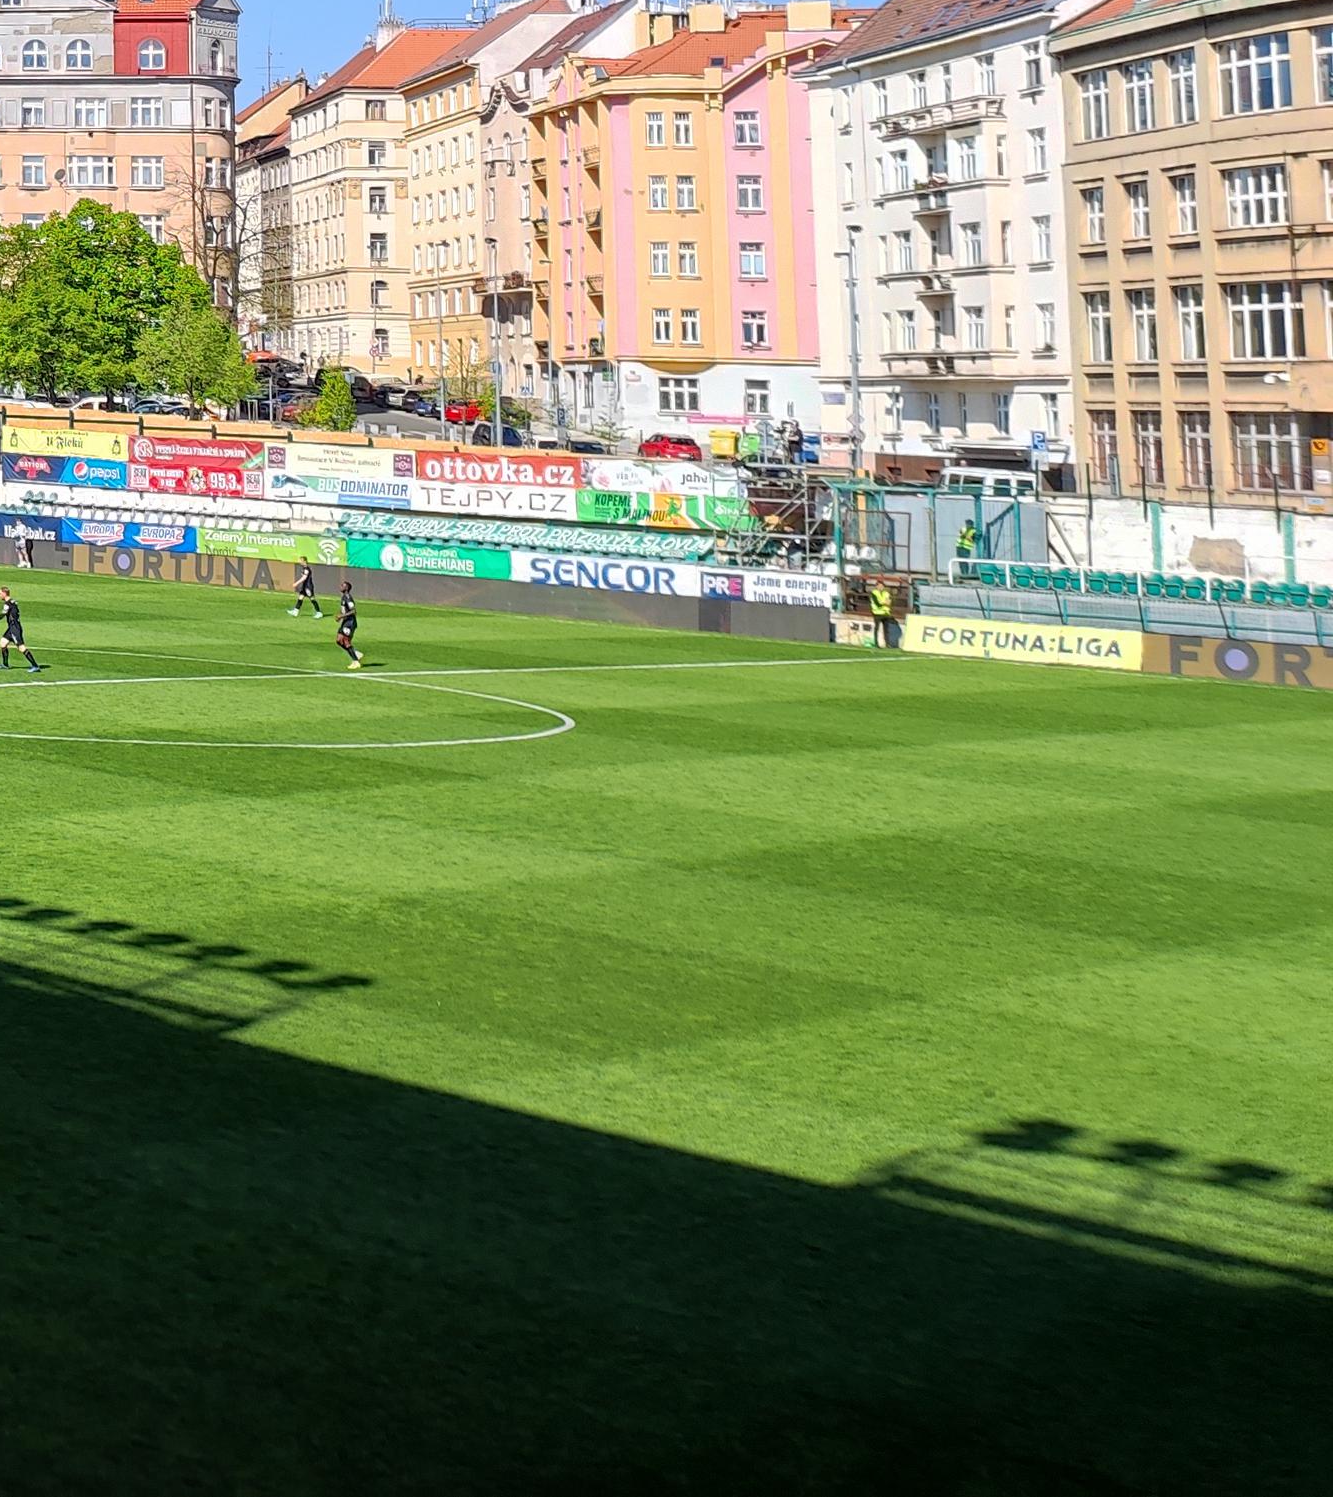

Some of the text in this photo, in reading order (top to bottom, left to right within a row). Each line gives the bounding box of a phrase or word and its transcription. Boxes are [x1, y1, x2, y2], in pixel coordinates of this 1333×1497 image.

[90, 467, 121, 481] pepsi
[425, 455, 576, 486] ottovka.cz
[420, 486, 569, 514] TEJPY.CZ
[594, 493, 633, 508] KOPEME
[613, 508, 620, 520] S
[204, 530, 296, 548] Zelený Internet
[89, 546, 276, 591] FORTUNA
[407, 555, 475, 572] BOHEMIANS
[530, 557, 677, 596] SENCOR
[702, 574, 828, 597] PRE Jsme energie
[754, 590, 825, 607] tohoto města
[1170, 635, 1333, 688] FOR
